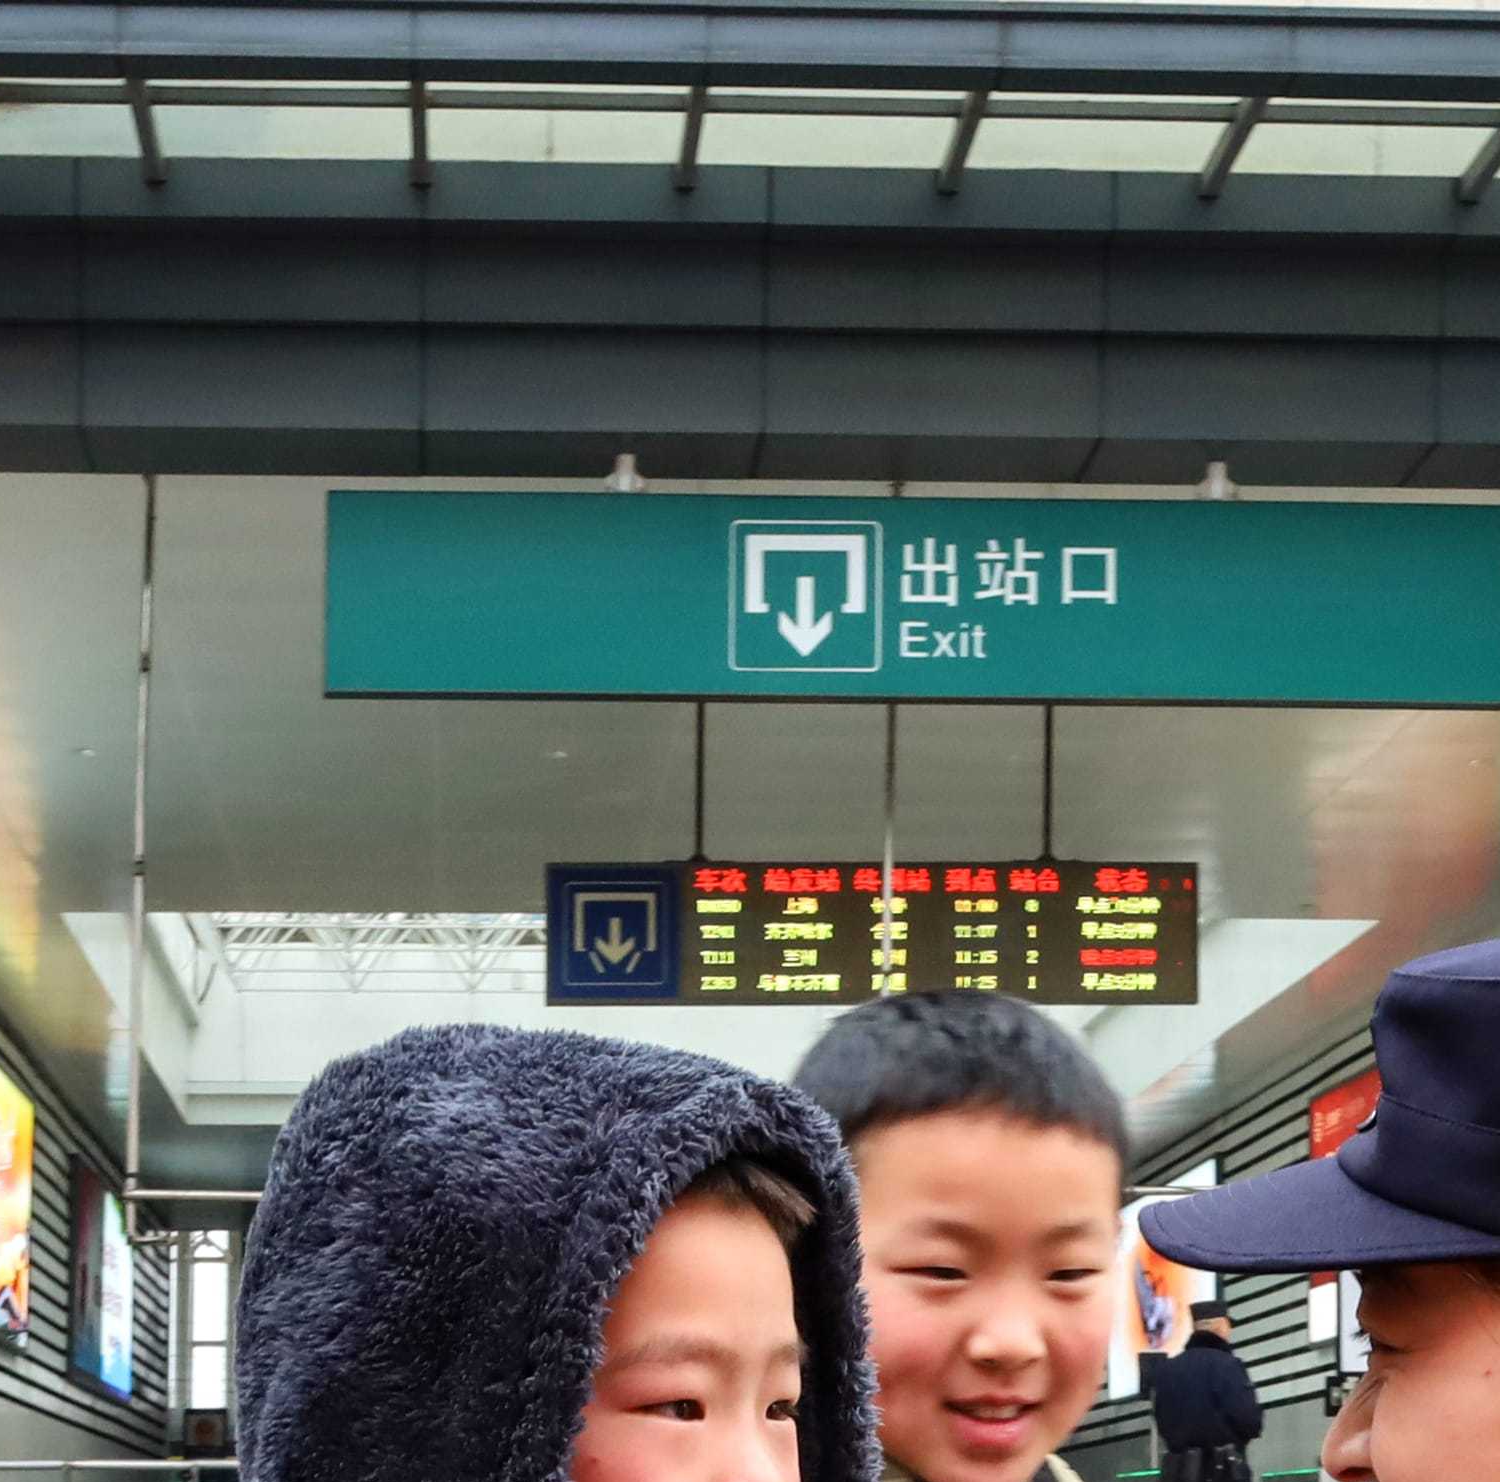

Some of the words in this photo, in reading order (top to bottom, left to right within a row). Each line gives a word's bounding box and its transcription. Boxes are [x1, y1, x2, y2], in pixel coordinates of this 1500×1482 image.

[901, 537, 1118, 606] 出站口
[900, 621, 987, 658] Exit
[693, 869, 747, 892] 车次
[764, 868, 841, 892] 始发站
[1009, 868, 1060, 892] 站台
[1026, 950, 1038, 964] 2
[1027, 976, 1037, 989] 1
